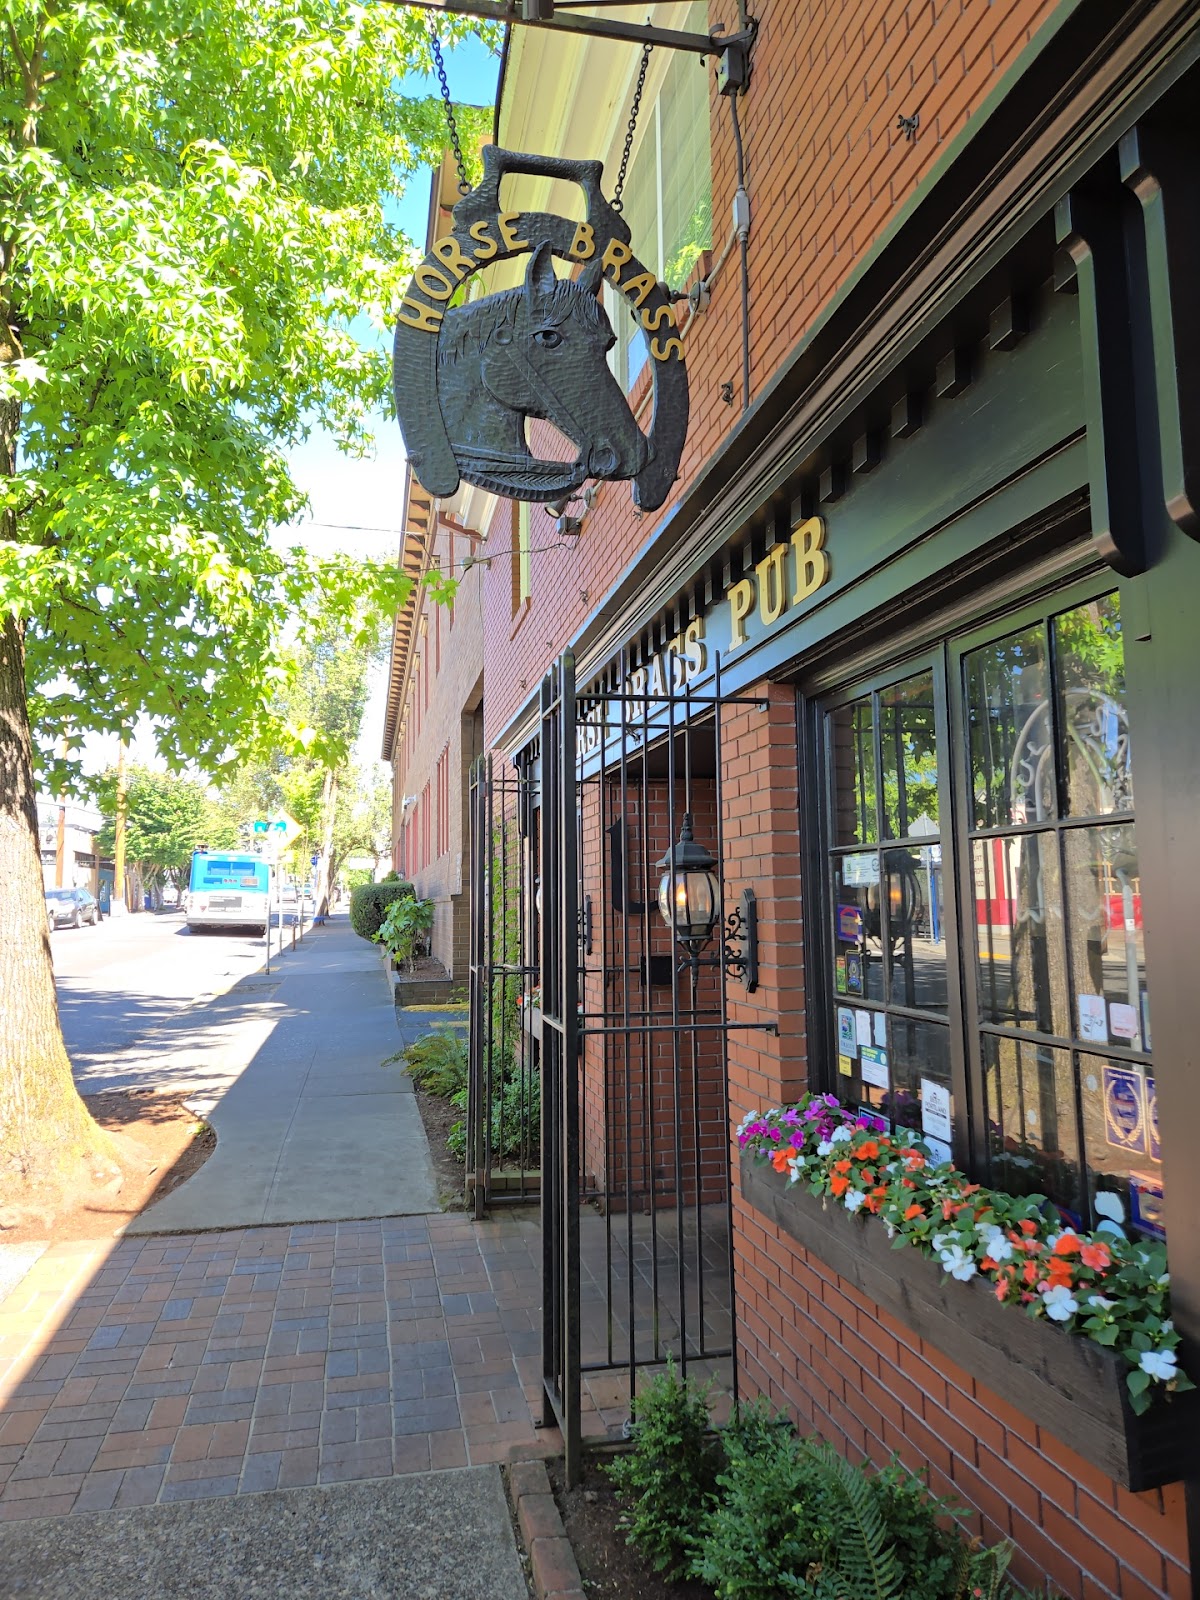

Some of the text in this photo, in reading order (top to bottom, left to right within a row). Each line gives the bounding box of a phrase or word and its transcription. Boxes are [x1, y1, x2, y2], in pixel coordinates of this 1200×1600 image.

[398, 211, 686, 362] HORSE BRASS
[726, 516, 830, 652] PUB
